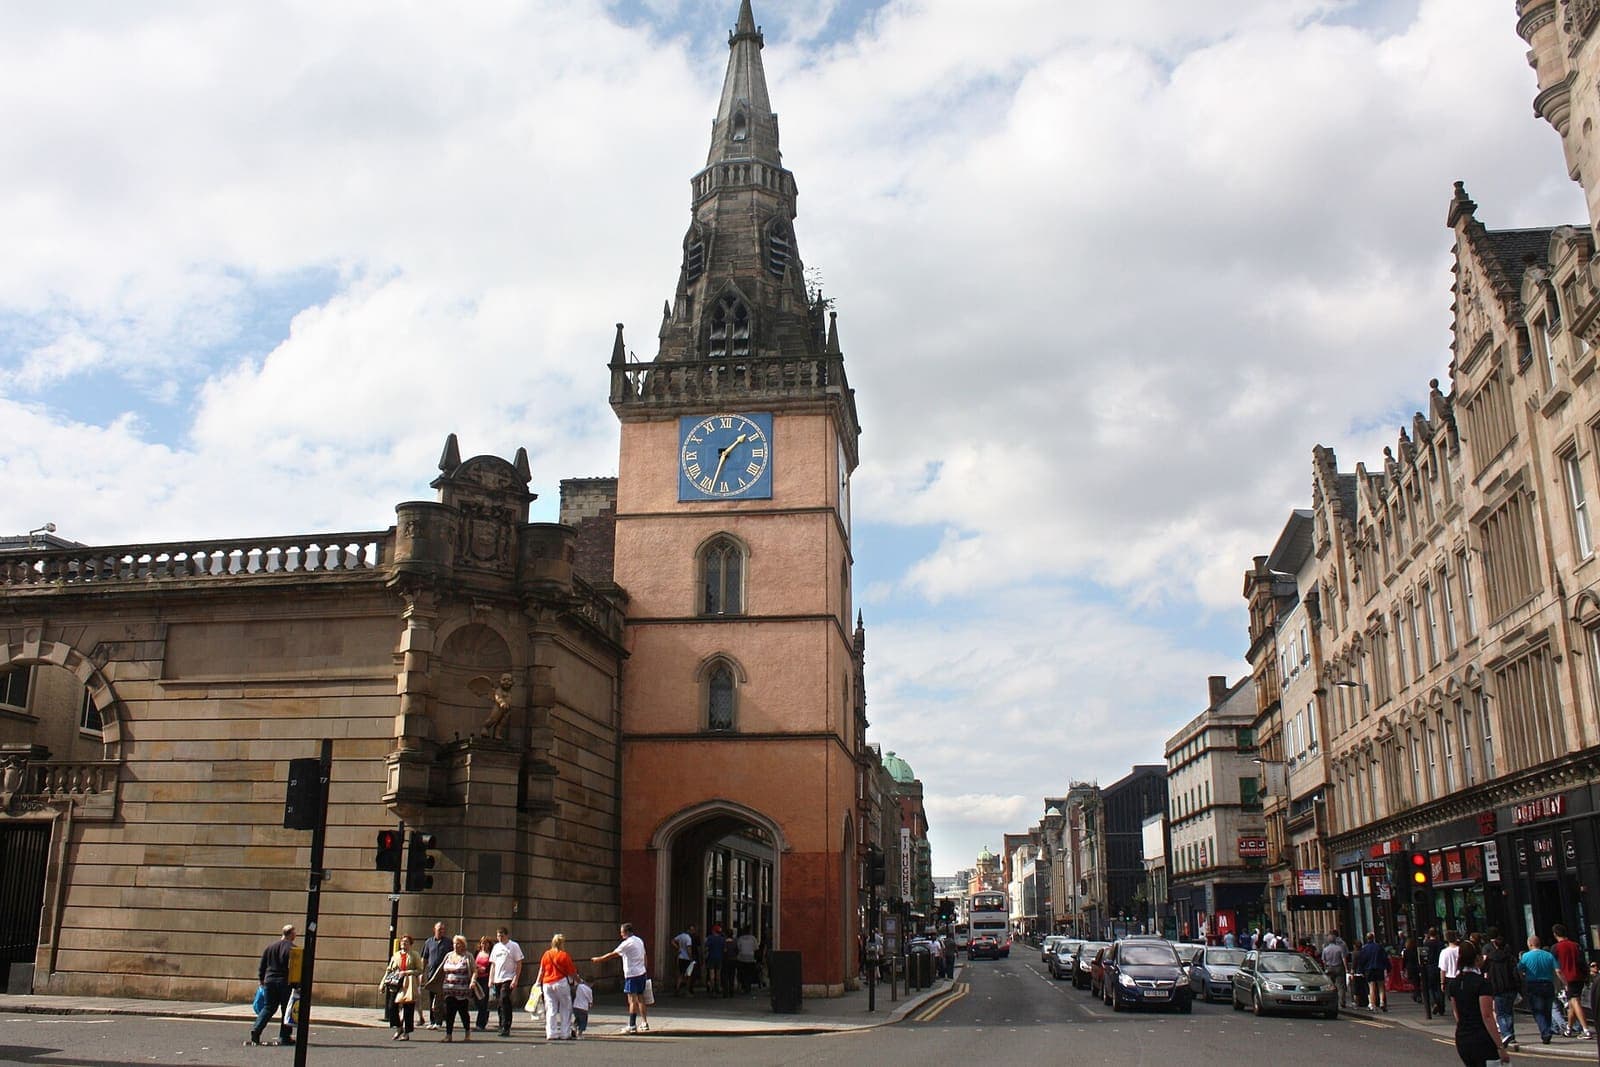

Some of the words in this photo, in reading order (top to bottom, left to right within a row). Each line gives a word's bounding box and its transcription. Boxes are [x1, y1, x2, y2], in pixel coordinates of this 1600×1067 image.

[703, 421, 715, 435] XI
[720, 418, 732, 428] XII
[738, 421, 746, 431] I
[690, 435, 703, 444] X
[748, 432, 760, 442] II
[686, 451, 697, 460] IX
[752, 449, 764, 458] III
[720, 482, 729, 492] VI
[738, 477, 746, 488] V
